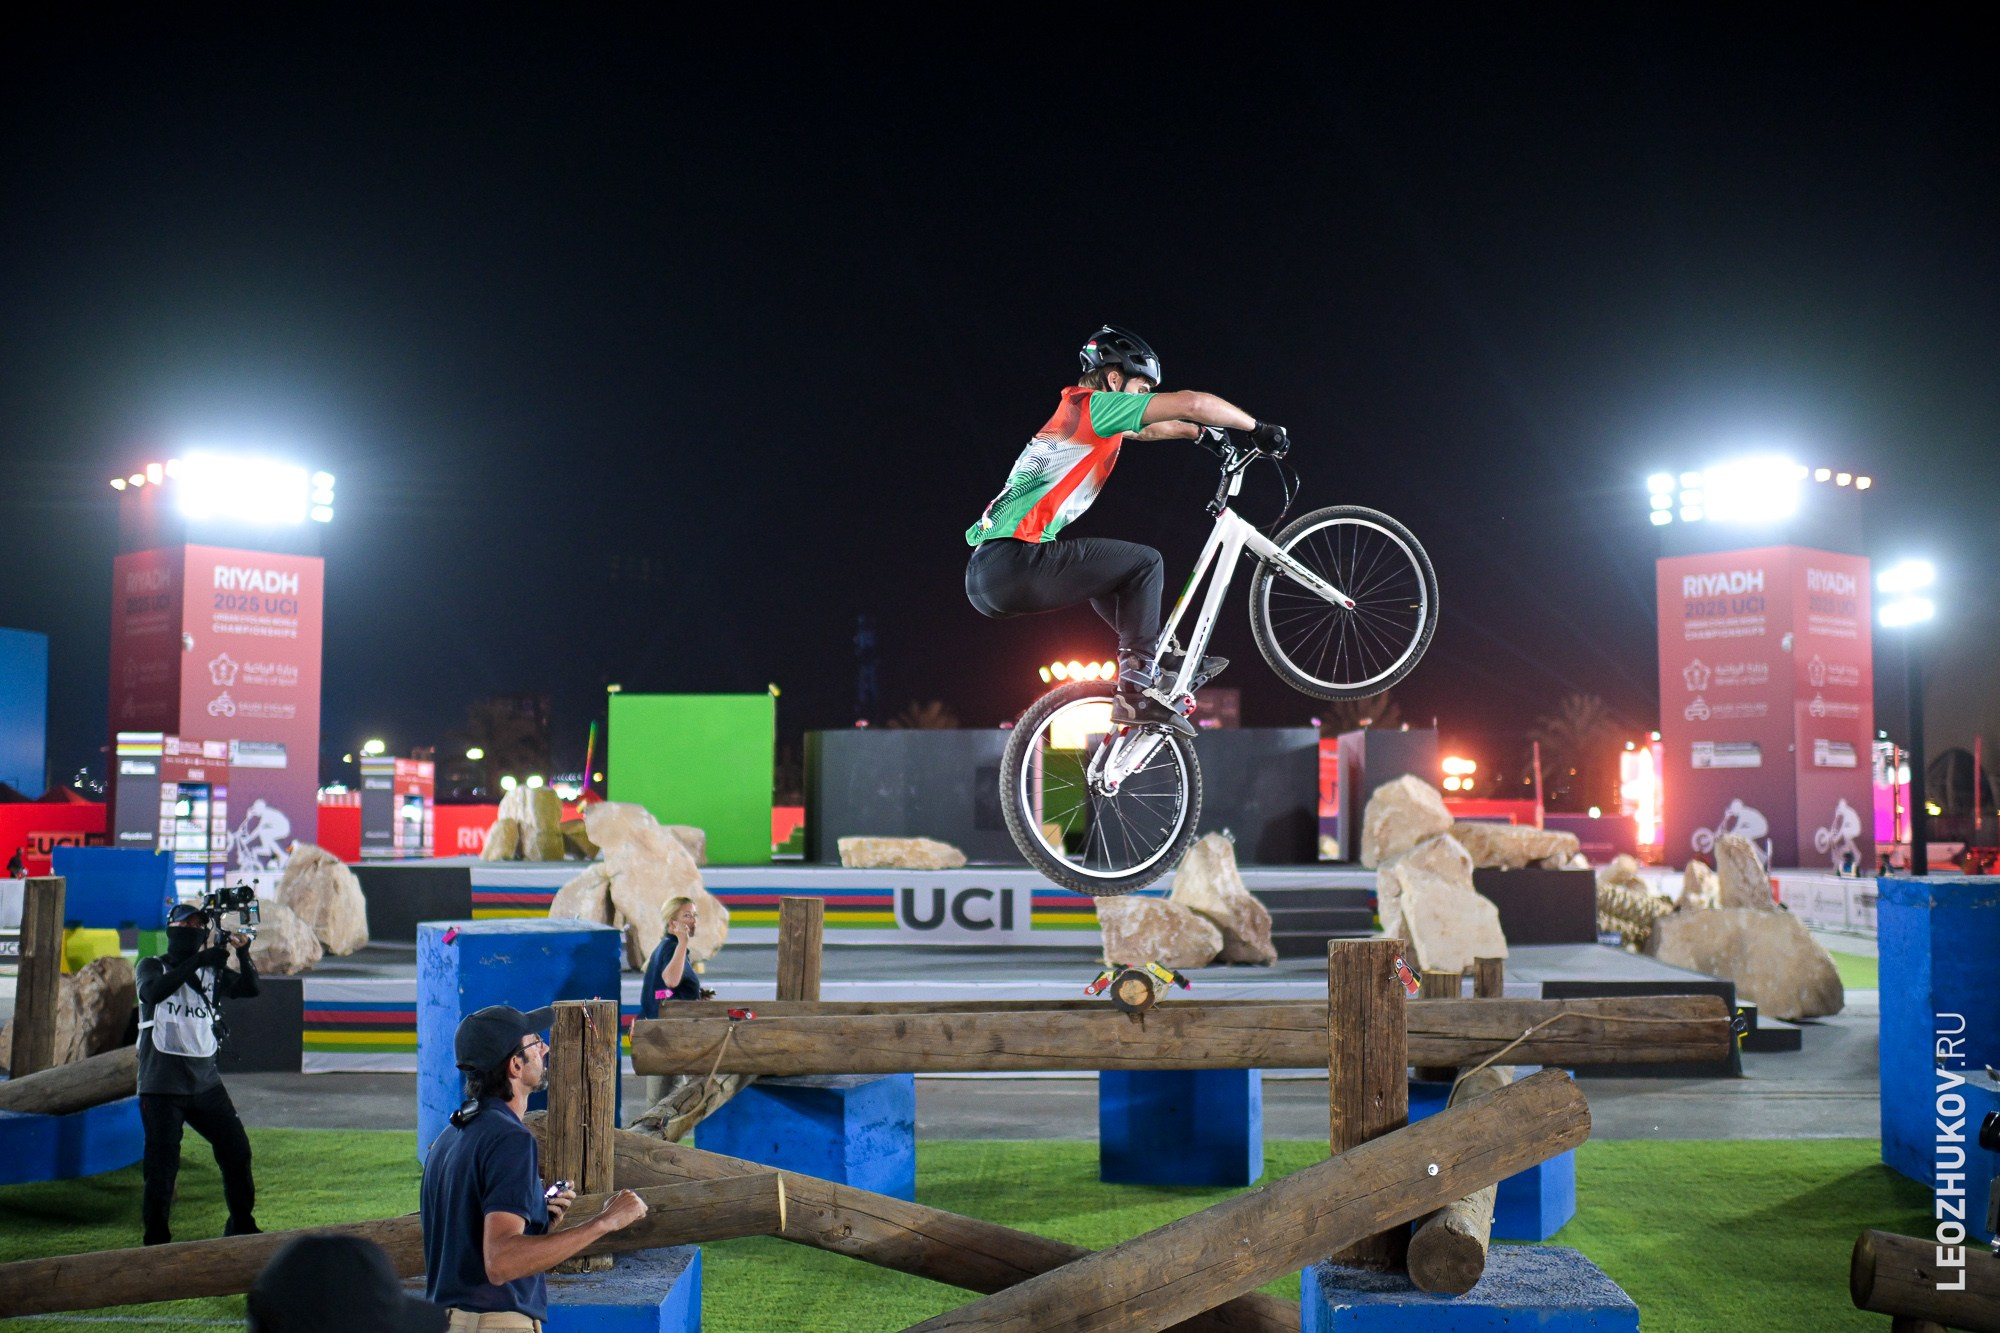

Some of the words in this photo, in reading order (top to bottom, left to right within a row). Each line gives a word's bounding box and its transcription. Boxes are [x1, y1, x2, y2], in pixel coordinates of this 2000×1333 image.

[214, 565, 298, 595] RIYADH
[1683, 569, 1765, 598] RIYADH
[1807, 567, 1857, 597] RIYADH
[214, 593, 260, 612] 2025
[264, 597, 298, 615] UCI
[1685, 601, 1728, 618] 2025
[1732, 596, 1765, 614] UCI
[1393, 644, 1421, 677] NATIONAL
[901, 888, 1013, 930] UCI
[166, 1001, 182, 1016] TV
